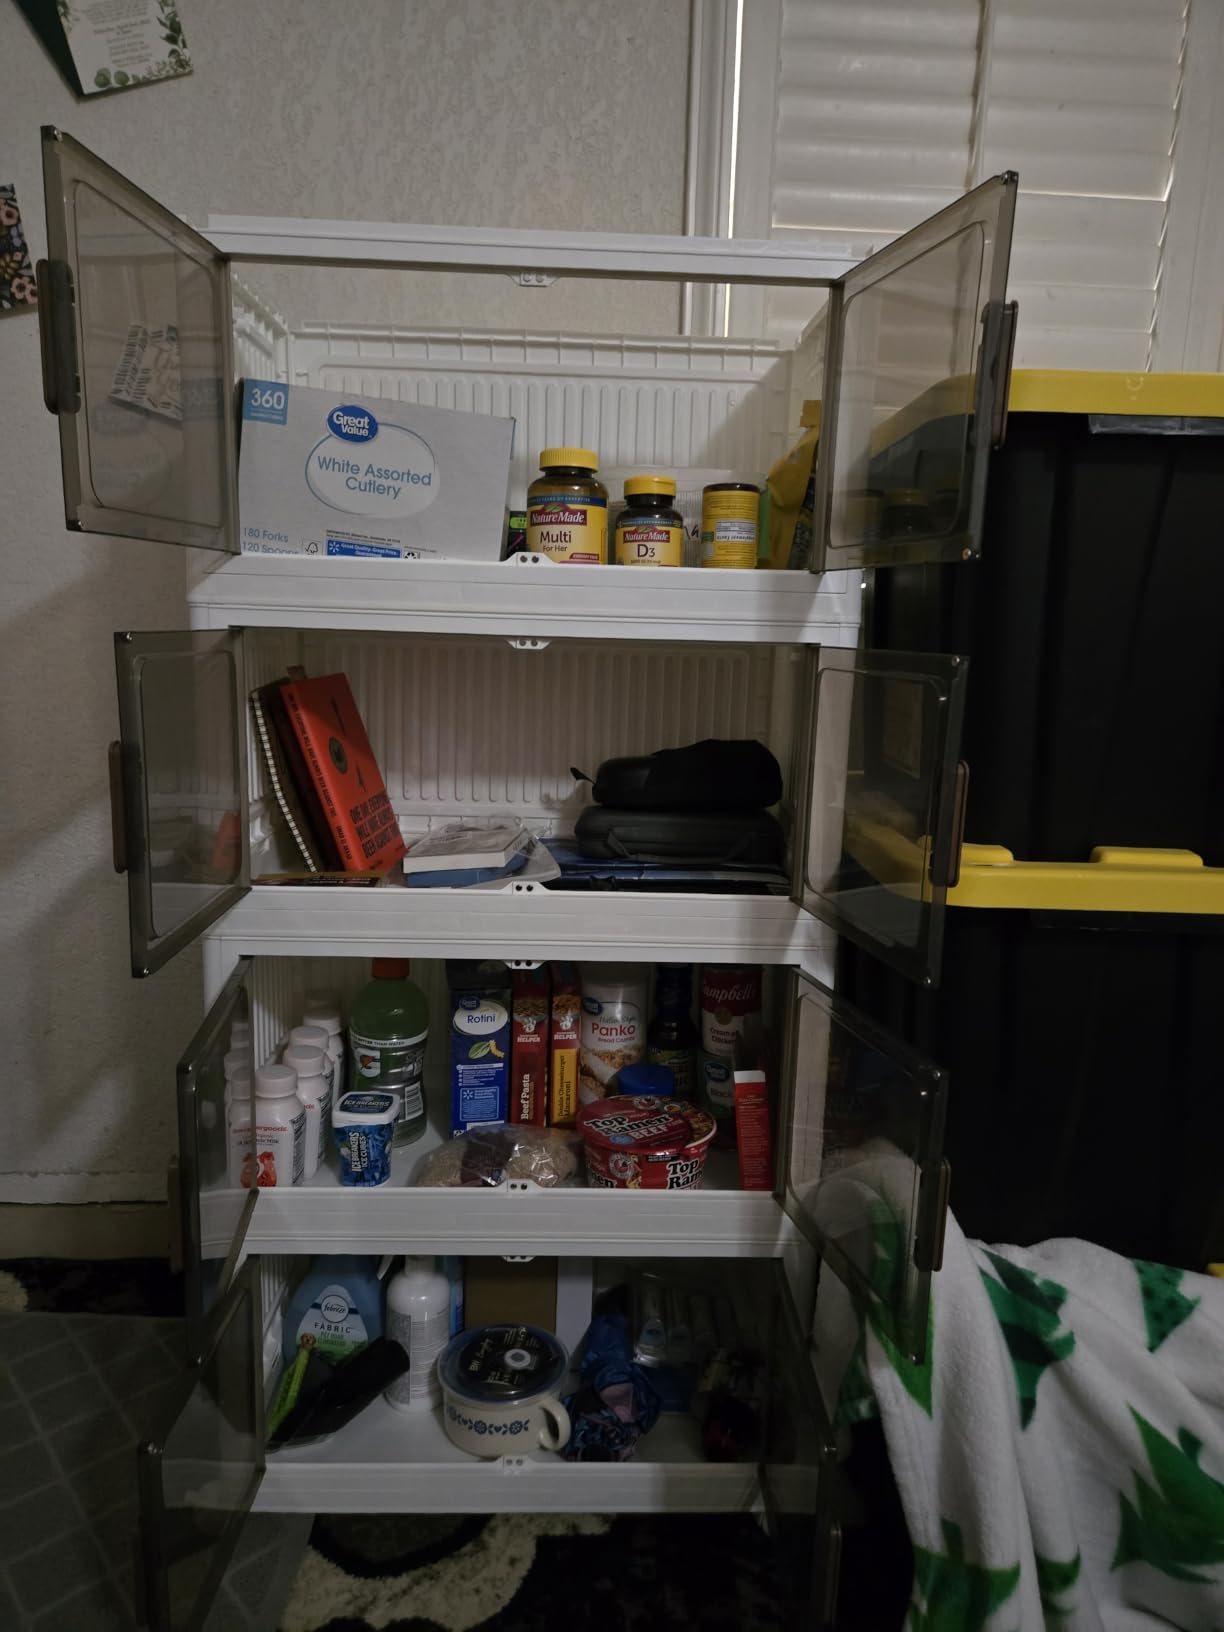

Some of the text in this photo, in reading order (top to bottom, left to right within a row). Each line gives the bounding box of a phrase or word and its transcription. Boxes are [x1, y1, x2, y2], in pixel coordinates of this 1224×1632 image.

[251, 388, 285, 410] 360
[333, 411, 370, 429] Great
[341, 425, 369, 437] Value
[317, 455, 432, 486] White Assorted
[345, 477, 401, 500] Cutlery
[243, 527, 289, 543] 180 Forks
[540, 530, 572, 544] Multi
[243, 541, 259, 554] 120
[467, 1014, 496, 1024] Rotini
[591, 1023, 636, 1036] Panko
[520, 1073, 530, 1120] Beef Pasta
[586, 1115, 627, 1128] Top
[602, 1114, 673, 1135] Ramen
[627, 1123, 669, 1139] BEEF
[668, 1159, 699, 1175] Top
[323, 1302, 347, 1314] febreze
[314, 1321, 352, 1334] FABRIC
